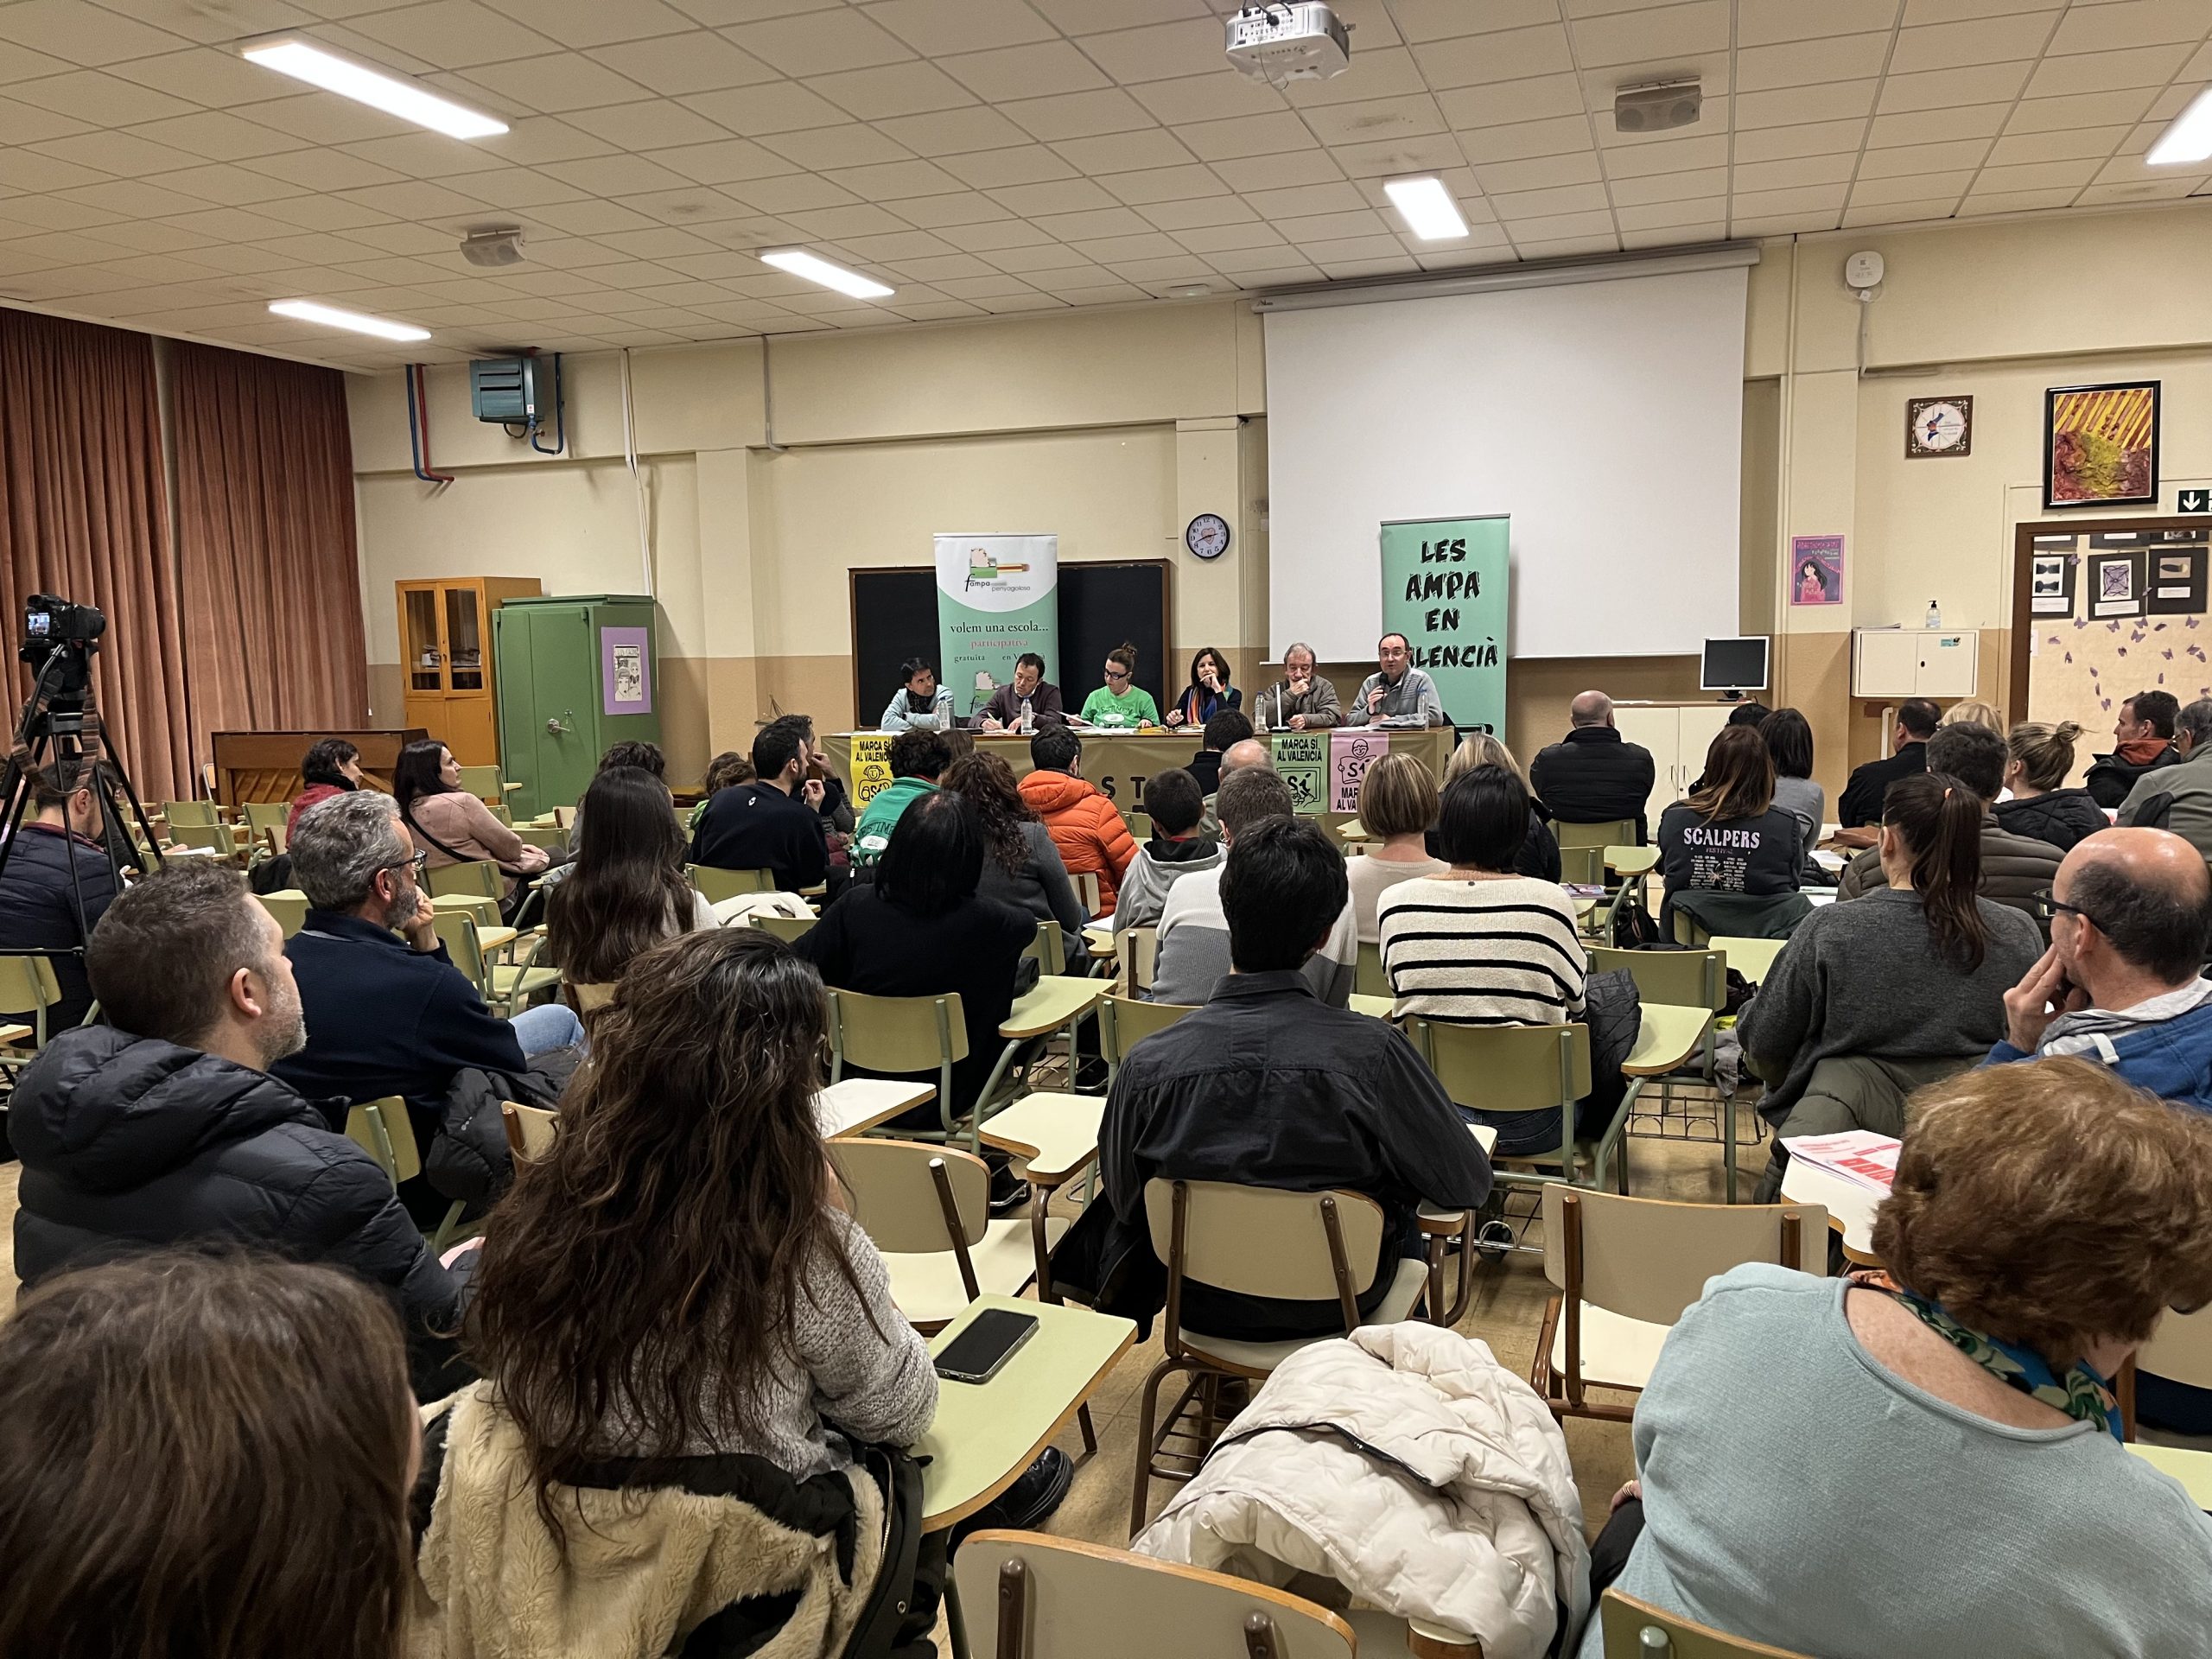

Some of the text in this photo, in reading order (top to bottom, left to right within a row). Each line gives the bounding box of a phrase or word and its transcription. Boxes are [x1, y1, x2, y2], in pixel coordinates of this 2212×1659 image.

[1421, 538, 1466, 563] LES
[965, 574, 990, 592] fampa
[1405, 571, 1481, 602] AMPA
[1426, 608, 1460, 632] EN
[950, 622, 982, 632] volem
[954, 654, 985, 664] gratuita
[860, 741, 882, 751] MARCA
[1282, 739, 1308, 750] MARCA
[855, 752, 888, 762] AL VALENC
[1277, 748, 1322, 761] AL VALENCIÀ
[1337, 799, 1345, 810] AL
[1684, 828, 1760, 849] SCALPERS
